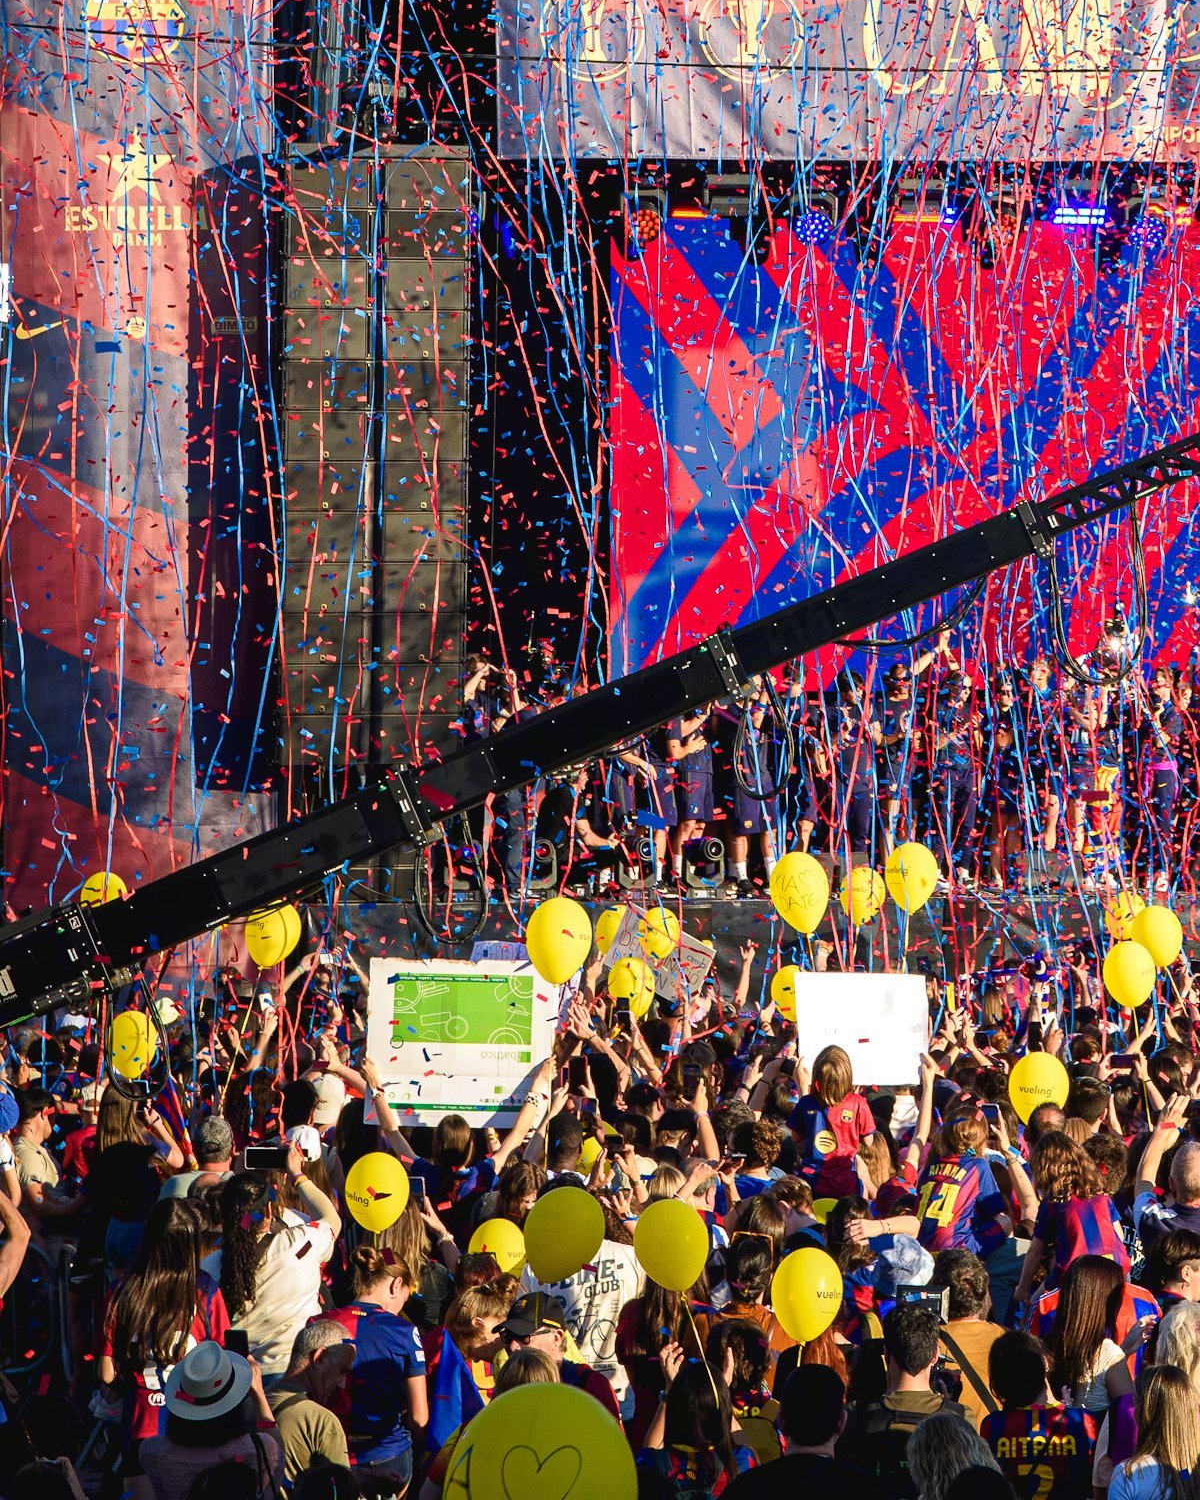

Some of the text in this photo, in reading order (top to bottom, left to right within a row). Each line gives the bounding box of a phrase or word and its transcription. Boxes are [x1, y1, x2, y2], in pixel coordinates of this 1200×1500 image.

[64, 205, 209, 232] ESTRELLA
[481, 1051, 518, 1062] bathco
[1019, 1085, 1053, 1098] vueling
[928, 1164, 968, 1182] AITANA
[346, 1190, 370, 1208] ueling
[920, 1182, 961, 1228] 14
[584, 1279, 620, 1299] CLUB
[996, 1434, 1078, 1459] AITANA
